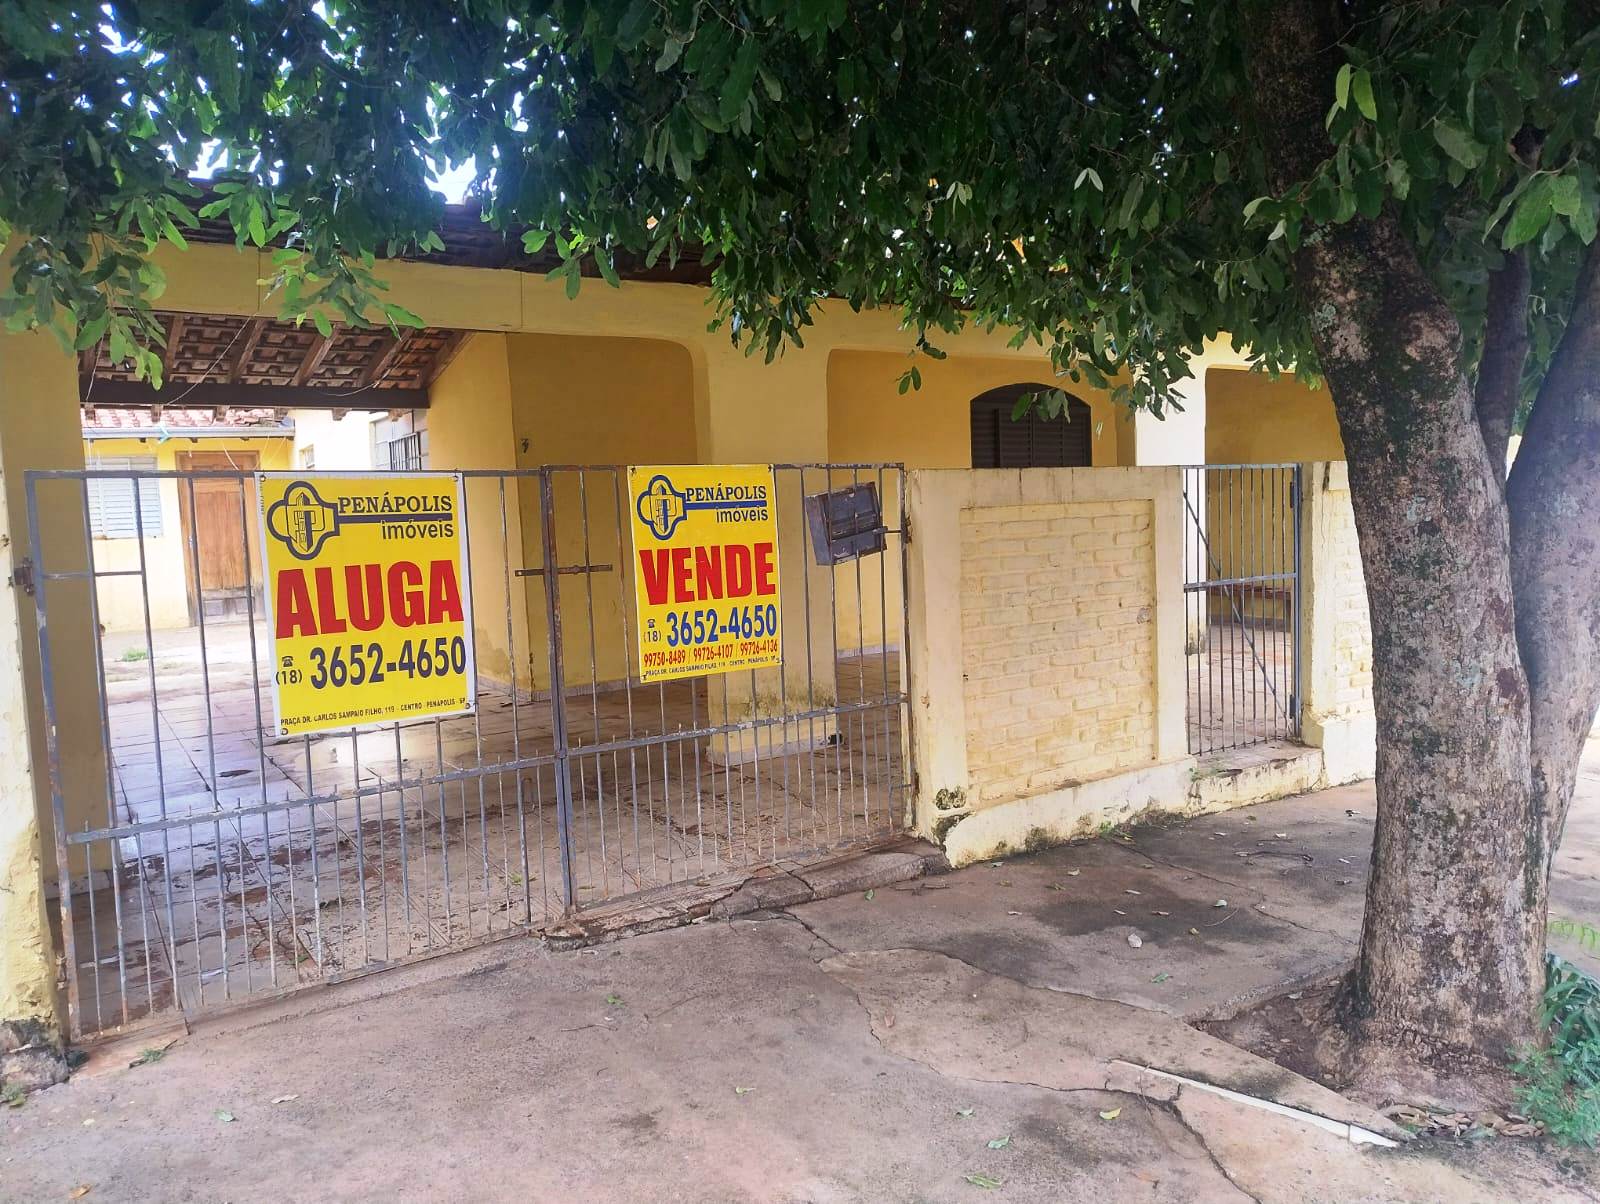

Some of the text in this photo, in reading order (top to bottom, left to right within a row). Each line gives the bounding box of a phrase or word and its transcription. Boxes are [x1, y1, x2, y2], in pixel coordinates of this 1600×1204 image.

[338, 492, 452, 514] PENÁPOLIS
[685, 482, 767, 502] PENÁPOLIS
[716, 506, 768, 524] imóveis
[381, 519, 454, 540] imóveis
[638, 542, 776, 606] VENDE
[276, 560, 464, 639] ALUGA
[643, 604, 777, 647] (18) 3652-4650
[275, 636, 466, 690] (18) 3652-4650
[644, 650, 686, 667] 99750-8489
[693, 644, 734, 662] 99726-4107
[280, 716, 300, 726] PRAÇA
[314, 712, 337, 722] CARLOS
[338, 710, 364, 719] SAMPAIO
[400, 702, 422, 711] CENTRO
